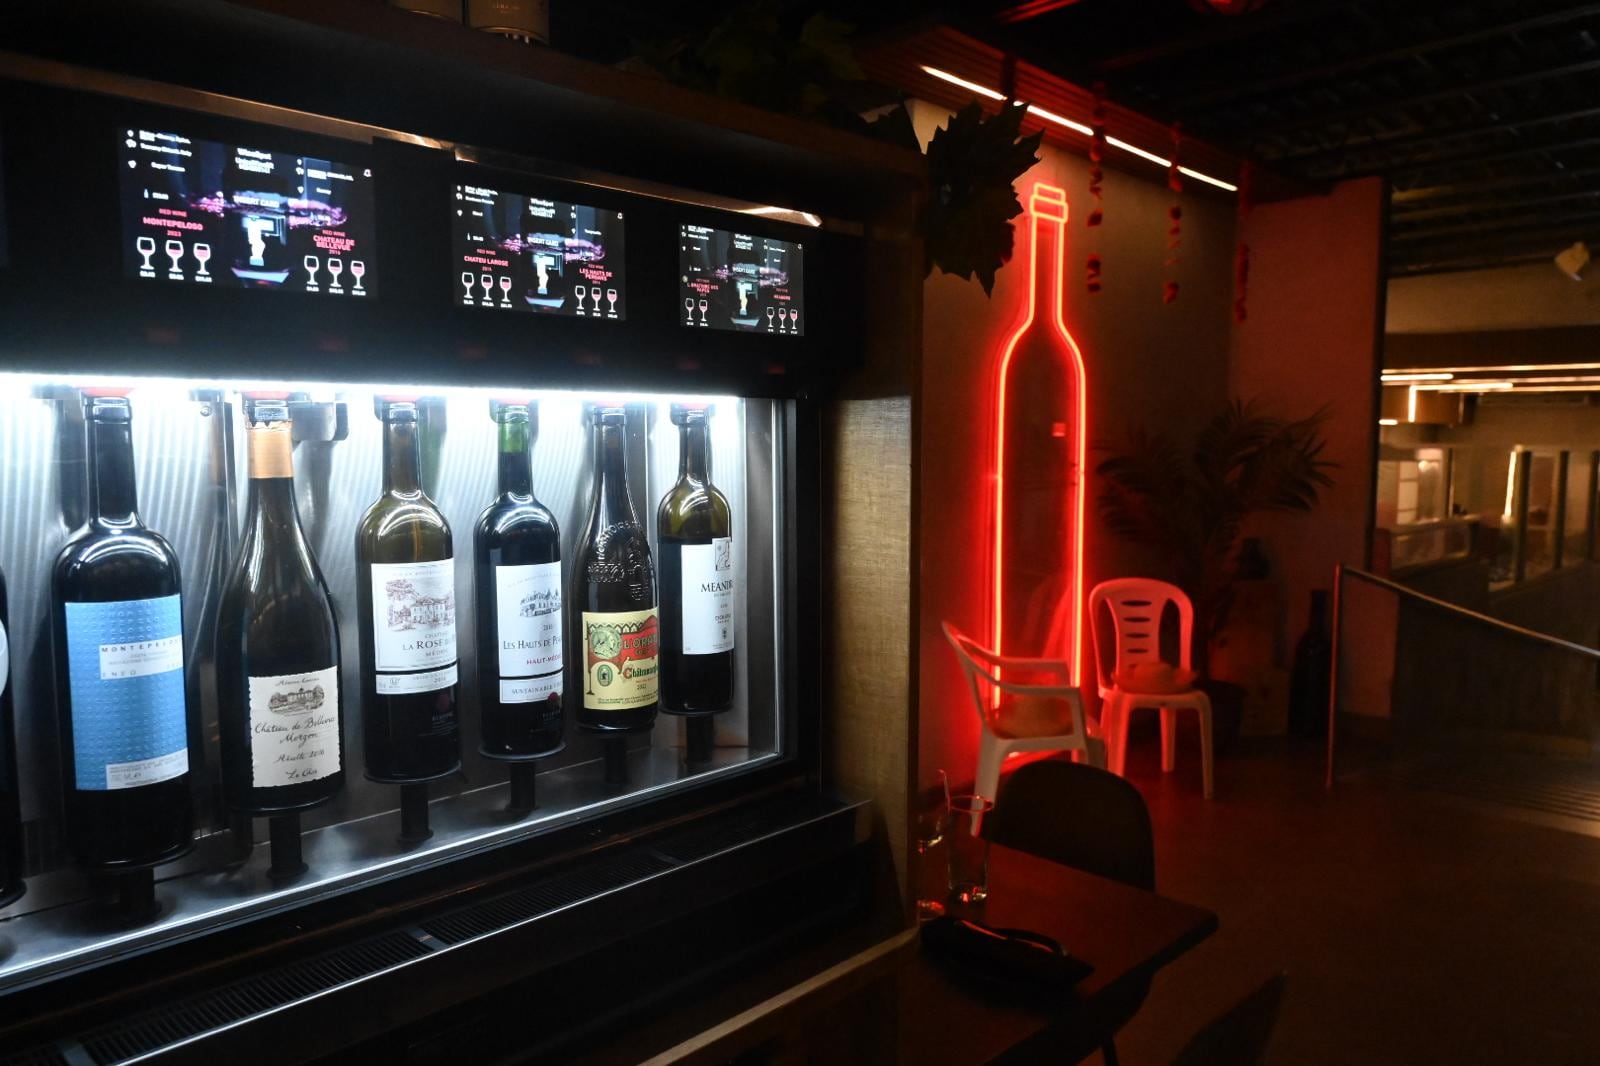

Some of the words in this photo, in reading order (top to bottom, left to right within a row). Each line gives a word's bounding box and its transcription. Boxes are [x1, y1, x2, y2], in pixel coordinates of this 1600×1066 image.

[172, 210, 187, 218] WINE
[143, 217, 203, 231] MONTEPELOSO
[313, 235, 345, 245] CHATEAU
[345, 239, 355, 247] DE
[316, 242, 352, 252] BELLEVUE
[280, 732, 319, 748] Morgon
